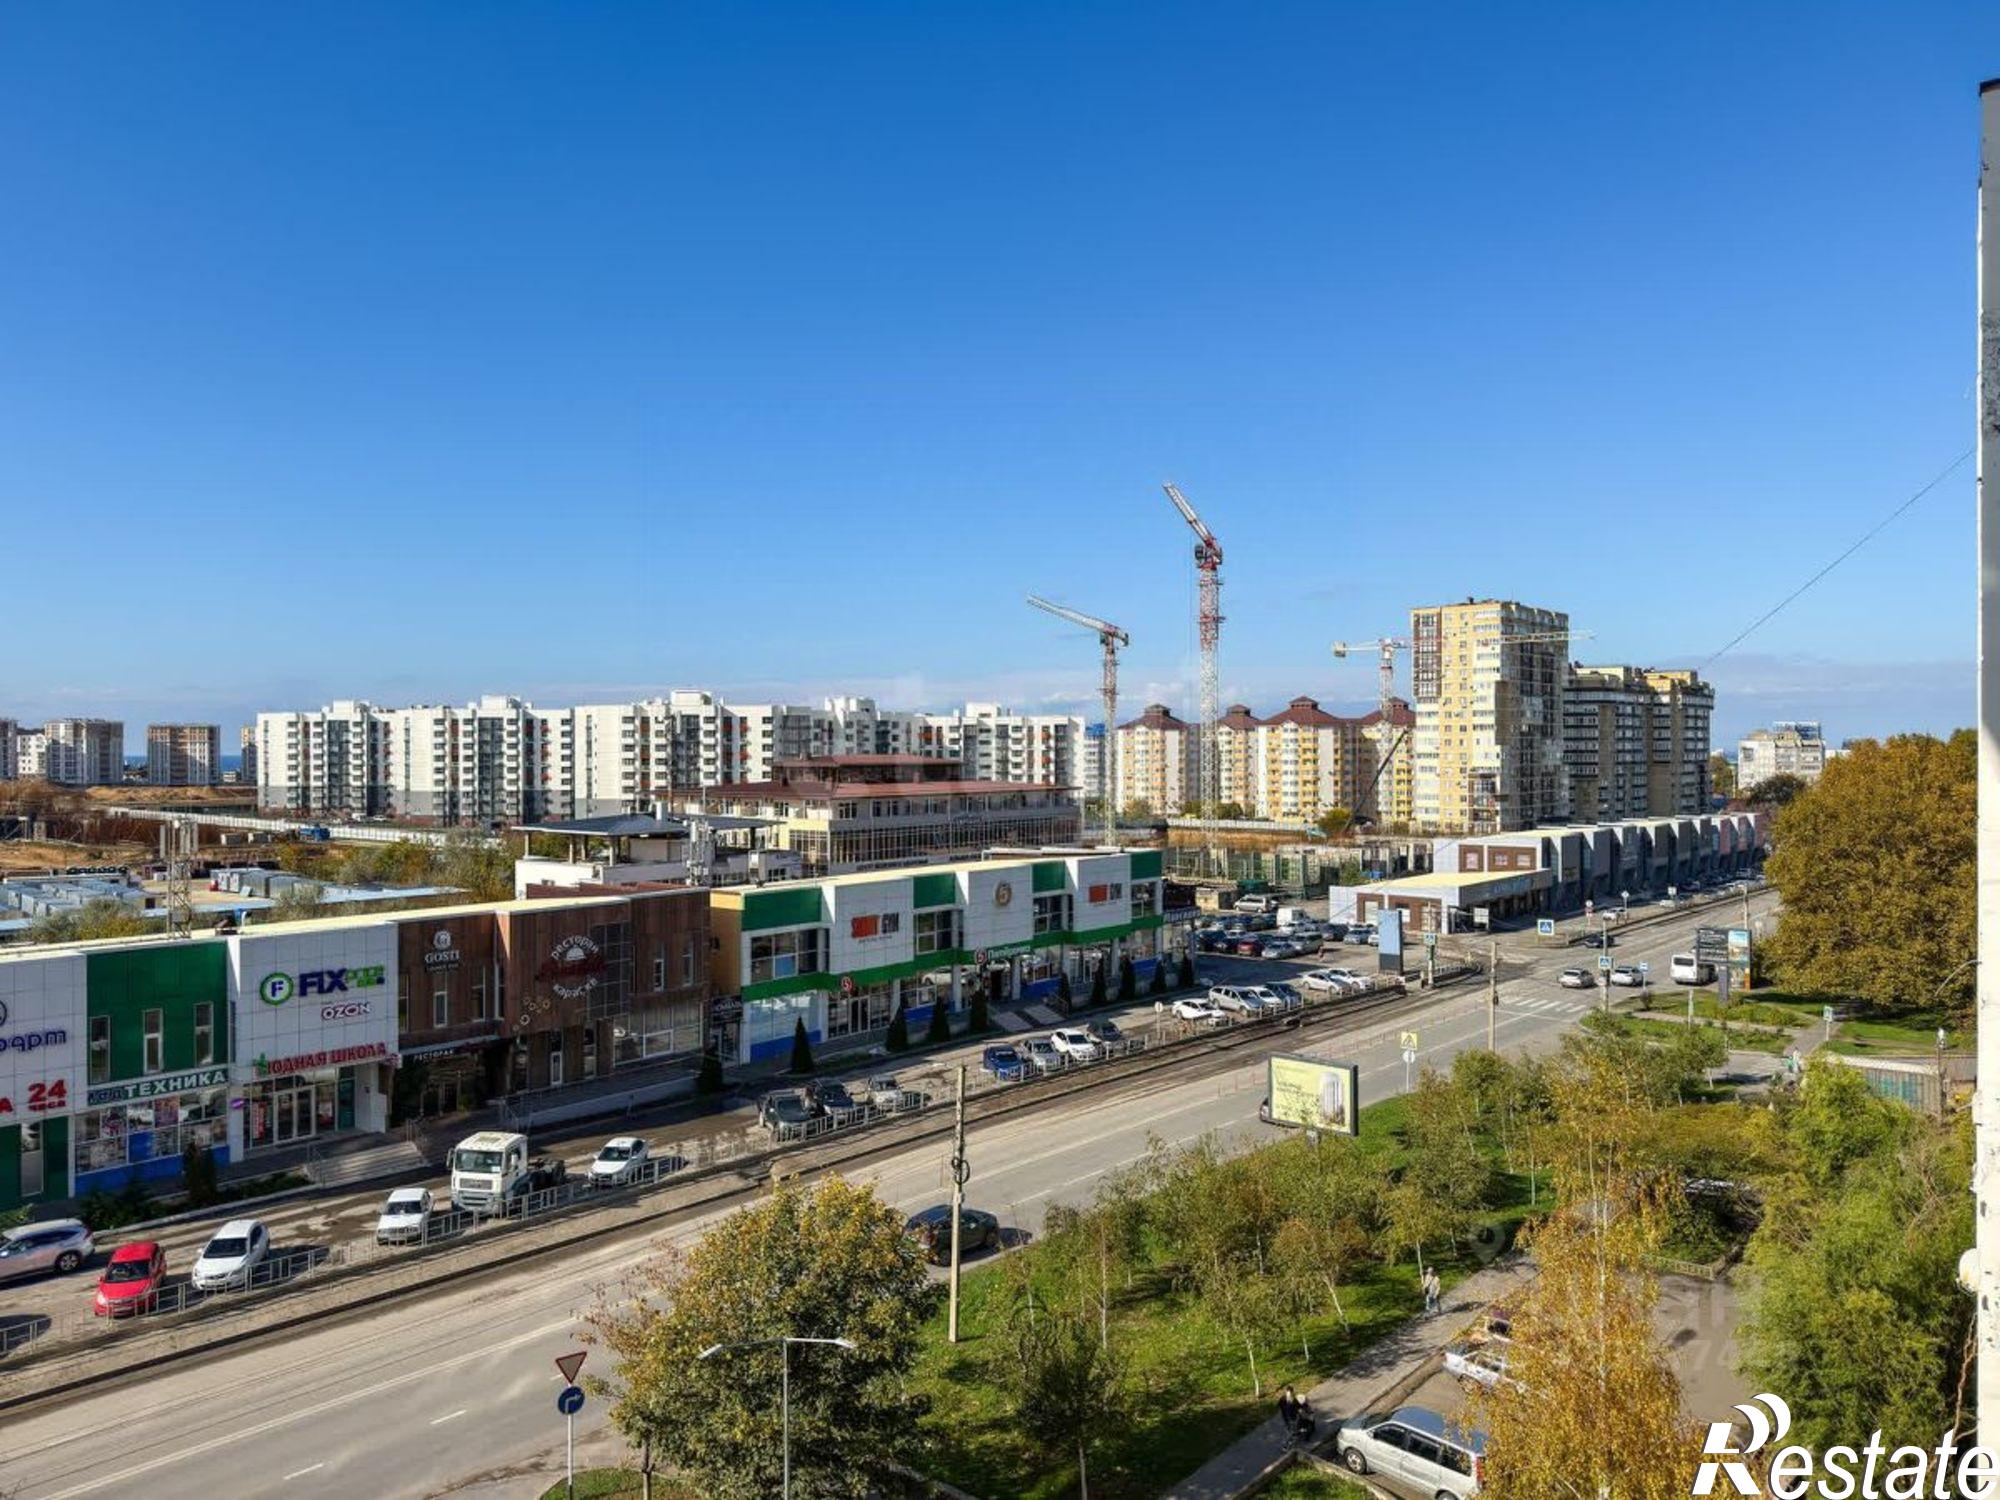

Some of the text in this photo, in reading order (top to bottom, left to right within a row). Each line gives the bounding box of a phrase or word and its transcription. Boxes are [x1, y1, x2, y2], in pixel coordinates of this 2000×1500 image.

[299, 968, 348, 997] FIX
[321, 1001, 371, 1021] OZON
[28, 1080, 67, 1104] 24
[124, 1070, 226, 1098] ТЕХНИКА
